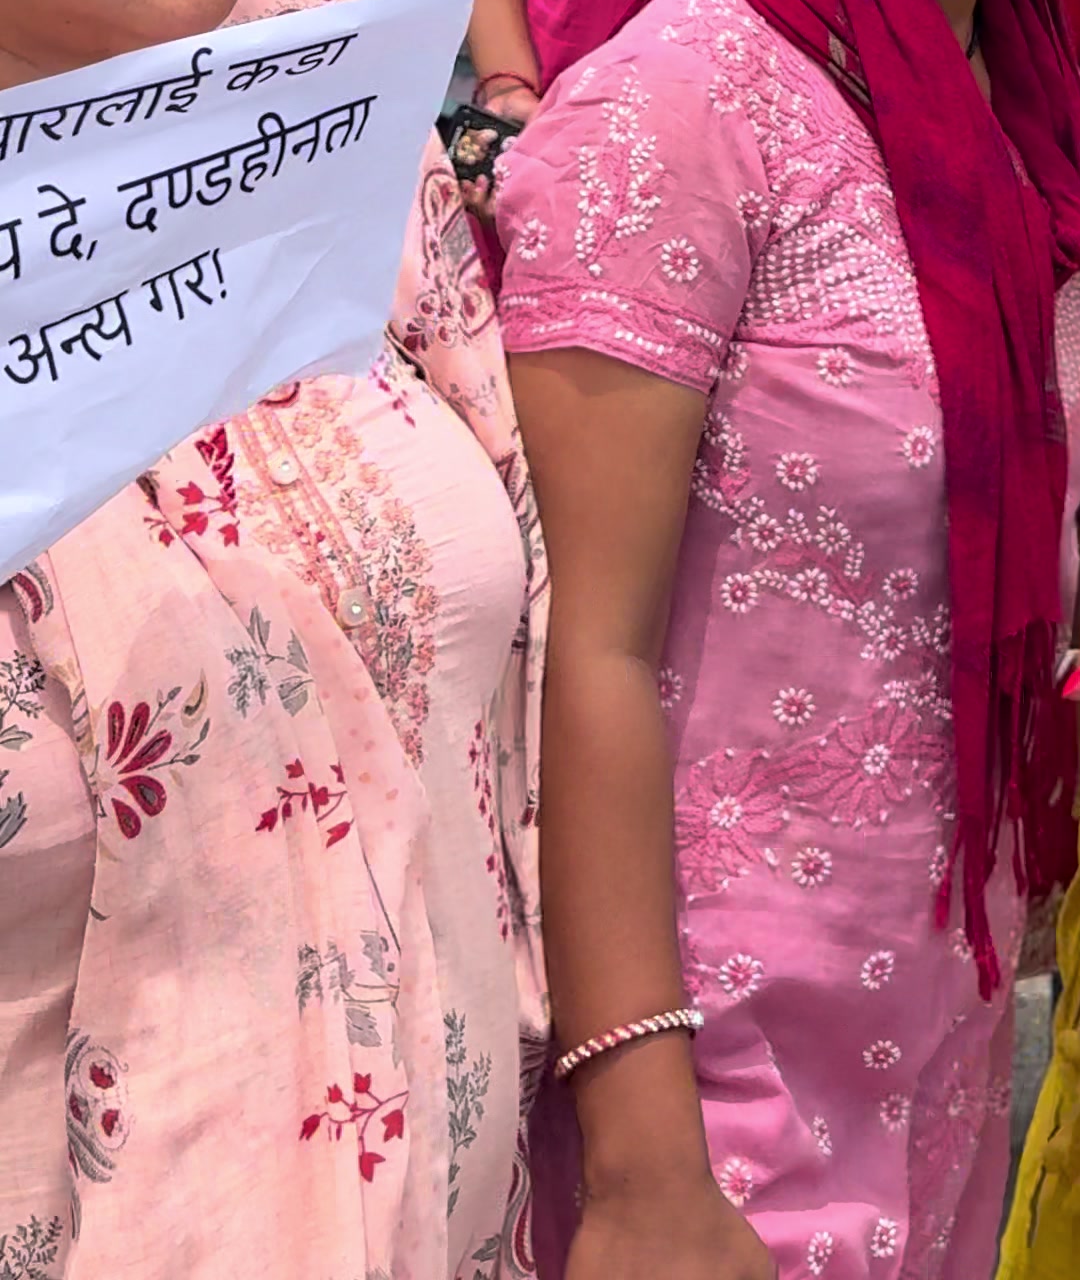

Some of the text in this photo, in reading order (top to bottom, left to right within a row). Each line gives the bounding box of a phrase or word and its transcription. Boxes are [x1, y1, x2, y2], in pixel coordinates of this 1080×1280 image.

[227, 33, 358, 93] कडा
[37, 184, 98, 261] दे,
[117, 96, 377, 232] दण्डहीनता
[4, 248, 228, 385] अन्त्य गर!
